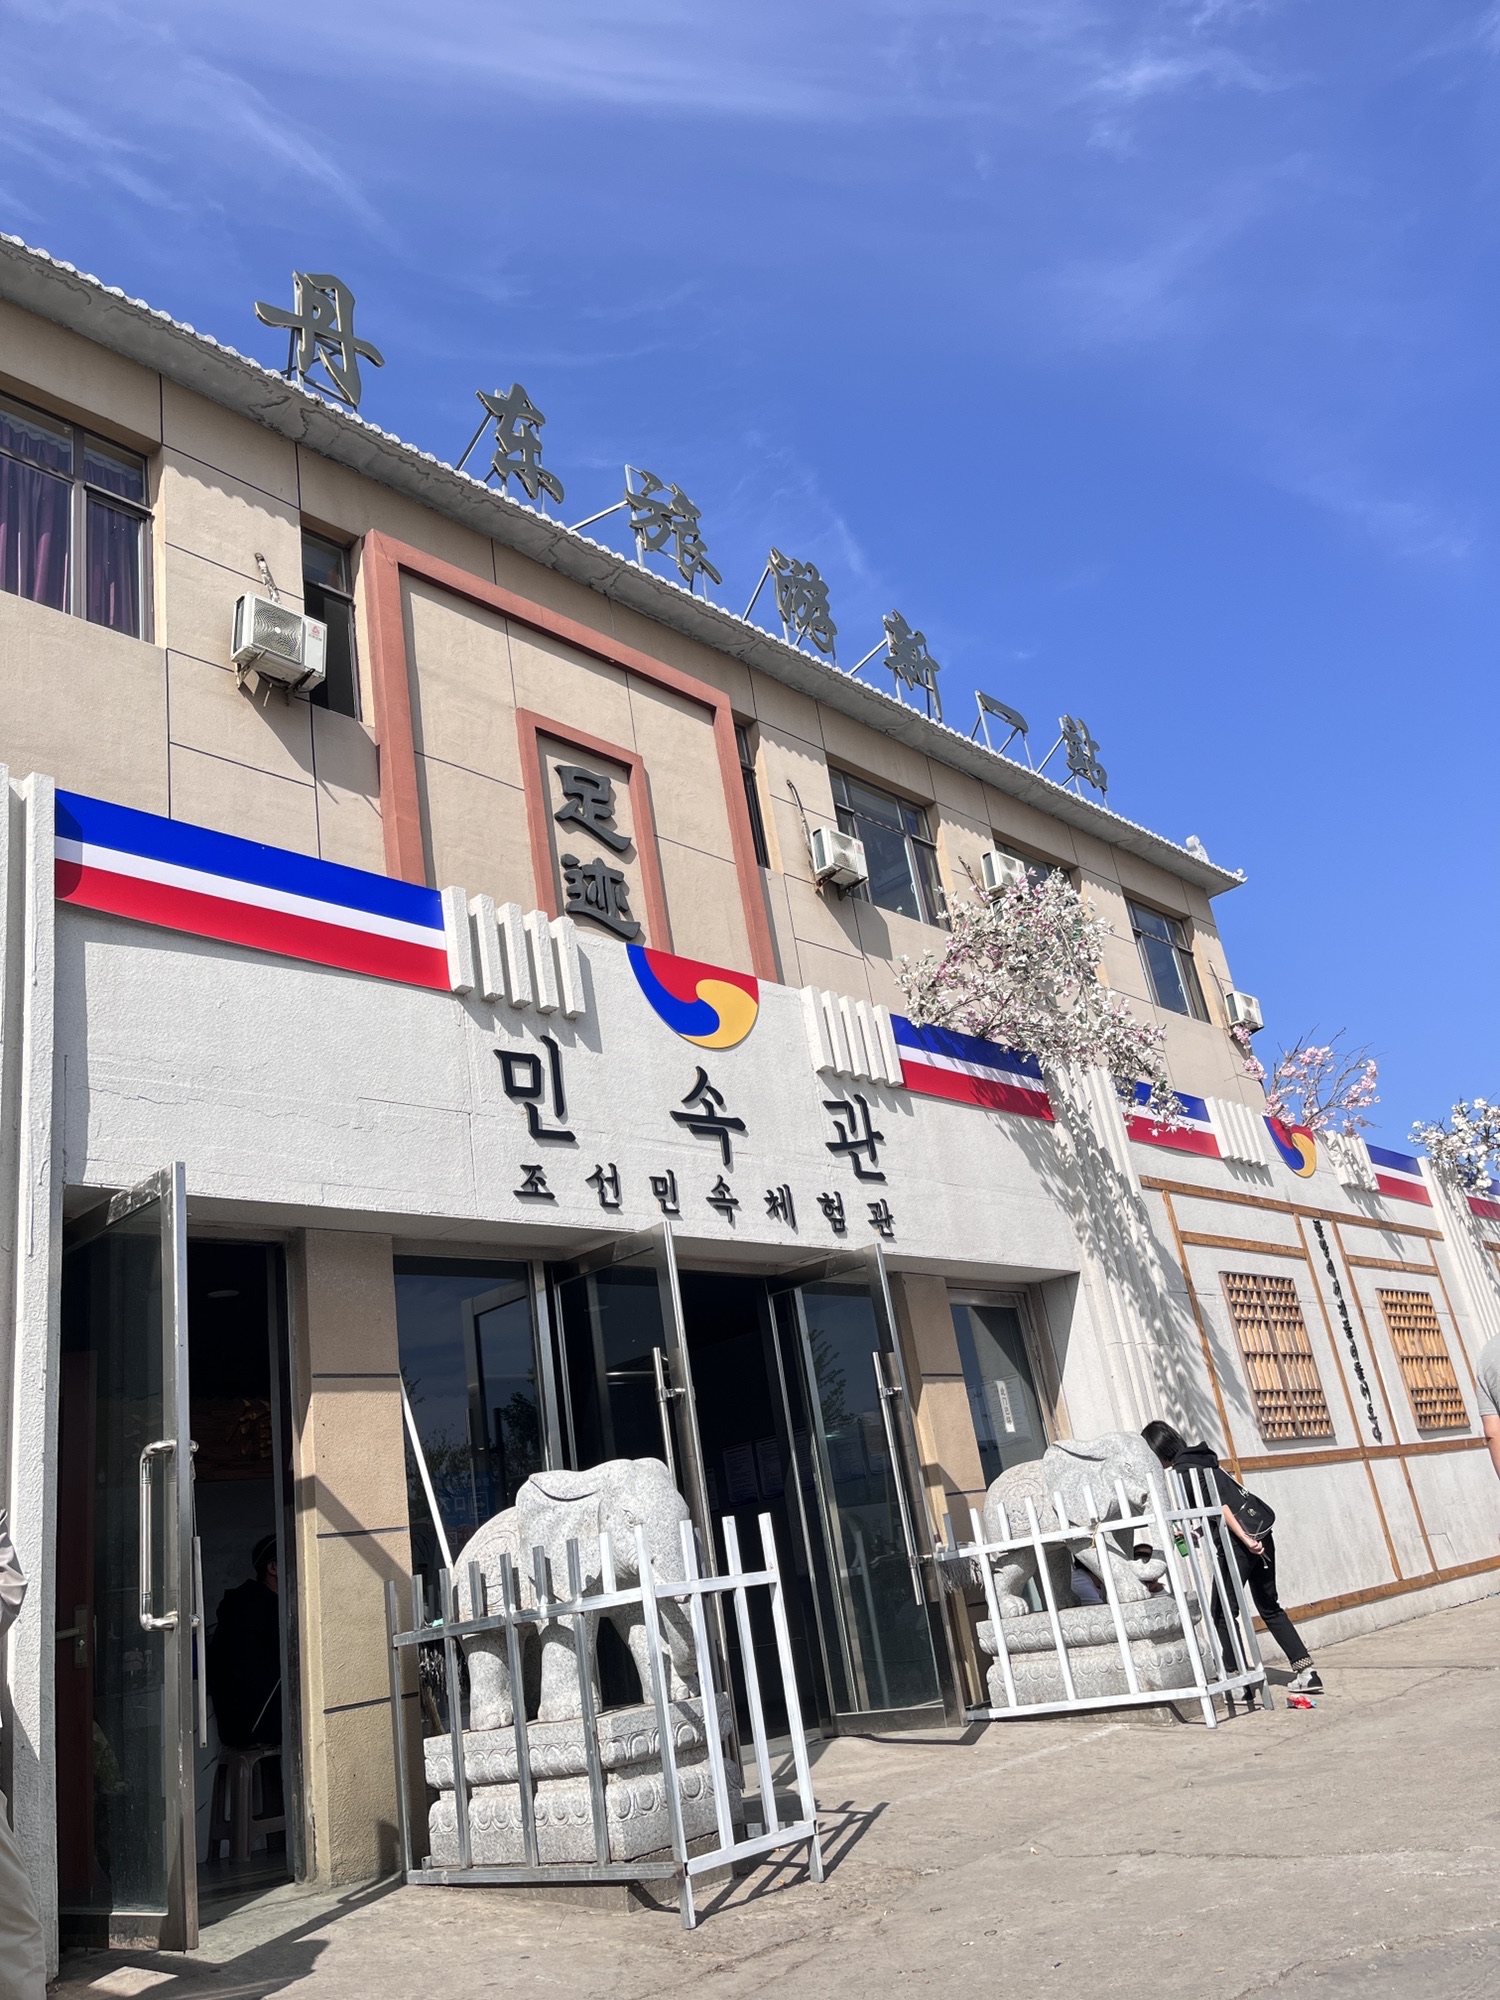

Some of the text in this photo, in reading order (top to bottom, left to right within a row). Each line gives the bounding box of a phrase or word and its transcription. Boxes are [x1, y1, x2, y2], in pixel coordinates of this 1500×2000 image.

[554, 764, 641, 940] 足迹
[493, 1035, 886, 1182] 민속관
[513, 1162, 894, 1237] 조선민속체험관
